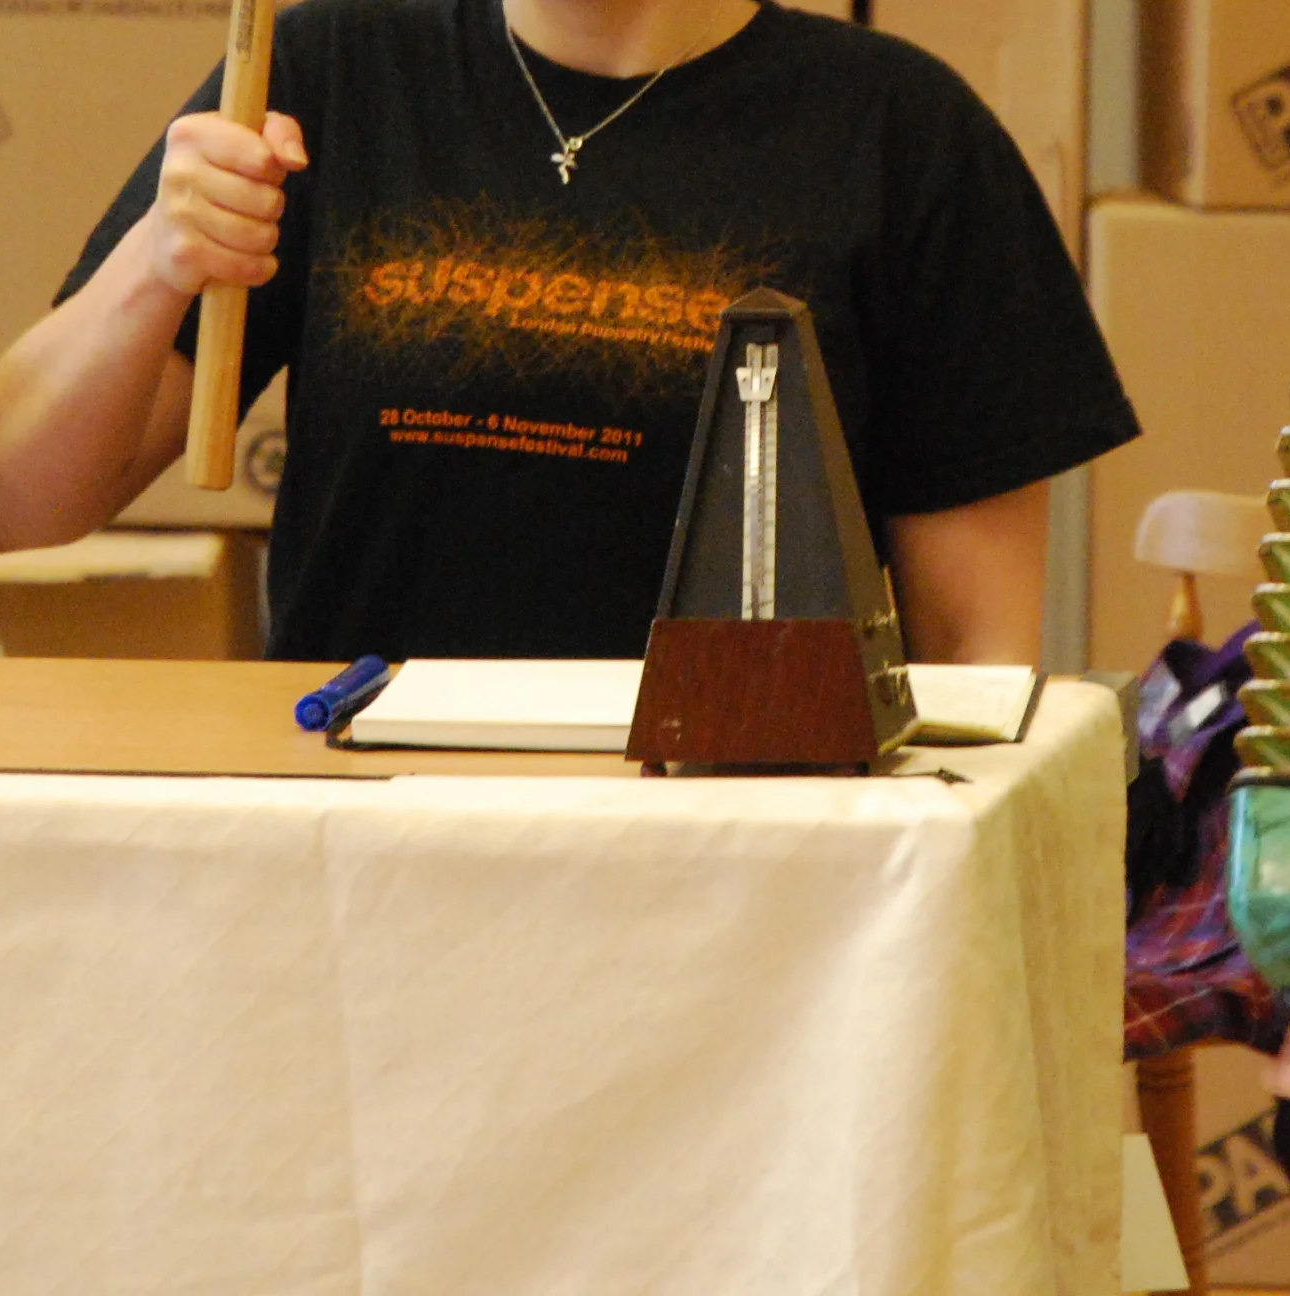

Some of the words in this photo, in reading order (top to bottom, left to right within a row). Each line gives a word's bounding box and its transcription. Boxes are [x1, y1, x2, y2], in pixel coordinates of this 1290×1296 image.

[364, 257, 731, 334] suspense
[380, 408, 400, 426] 28
[402, 408, 472, 428] October
[487, 413, 500, 431] 6
[503, 415, 597, 442] November
[600, 426, 644, 448] 2011
[389, 428, 629, 464] www.suspensefestival.com
